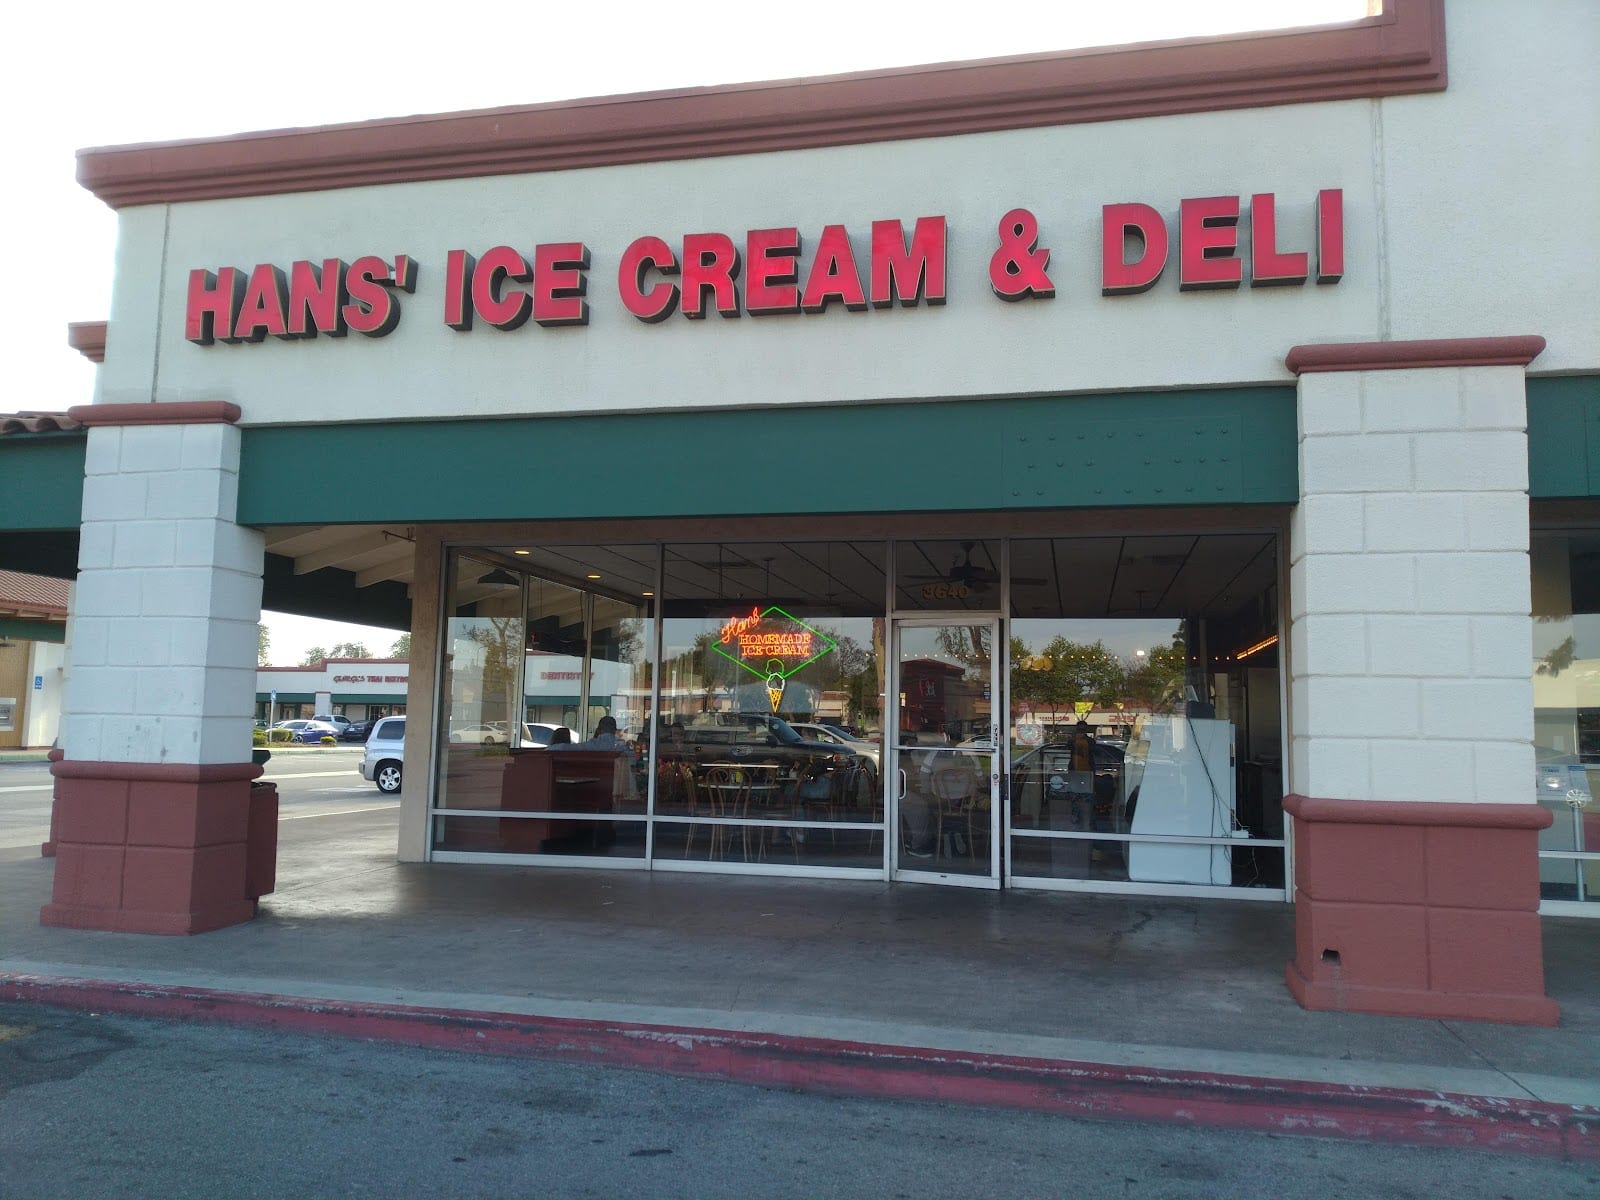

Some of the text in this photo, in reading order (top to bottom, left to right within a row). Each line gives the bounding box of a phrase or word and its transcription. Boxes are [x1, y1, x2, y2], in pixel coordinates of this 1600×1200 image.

[185, 188, 1343, 345] HANS' ICE CREAM & DELI
[921, 583, 970, 601] 3640
[739, 633, 811, 645] HOMEMADE
[741, 645, 811, 657] ICE CREAM
[540, 671, 595, 681] DENTISTY
